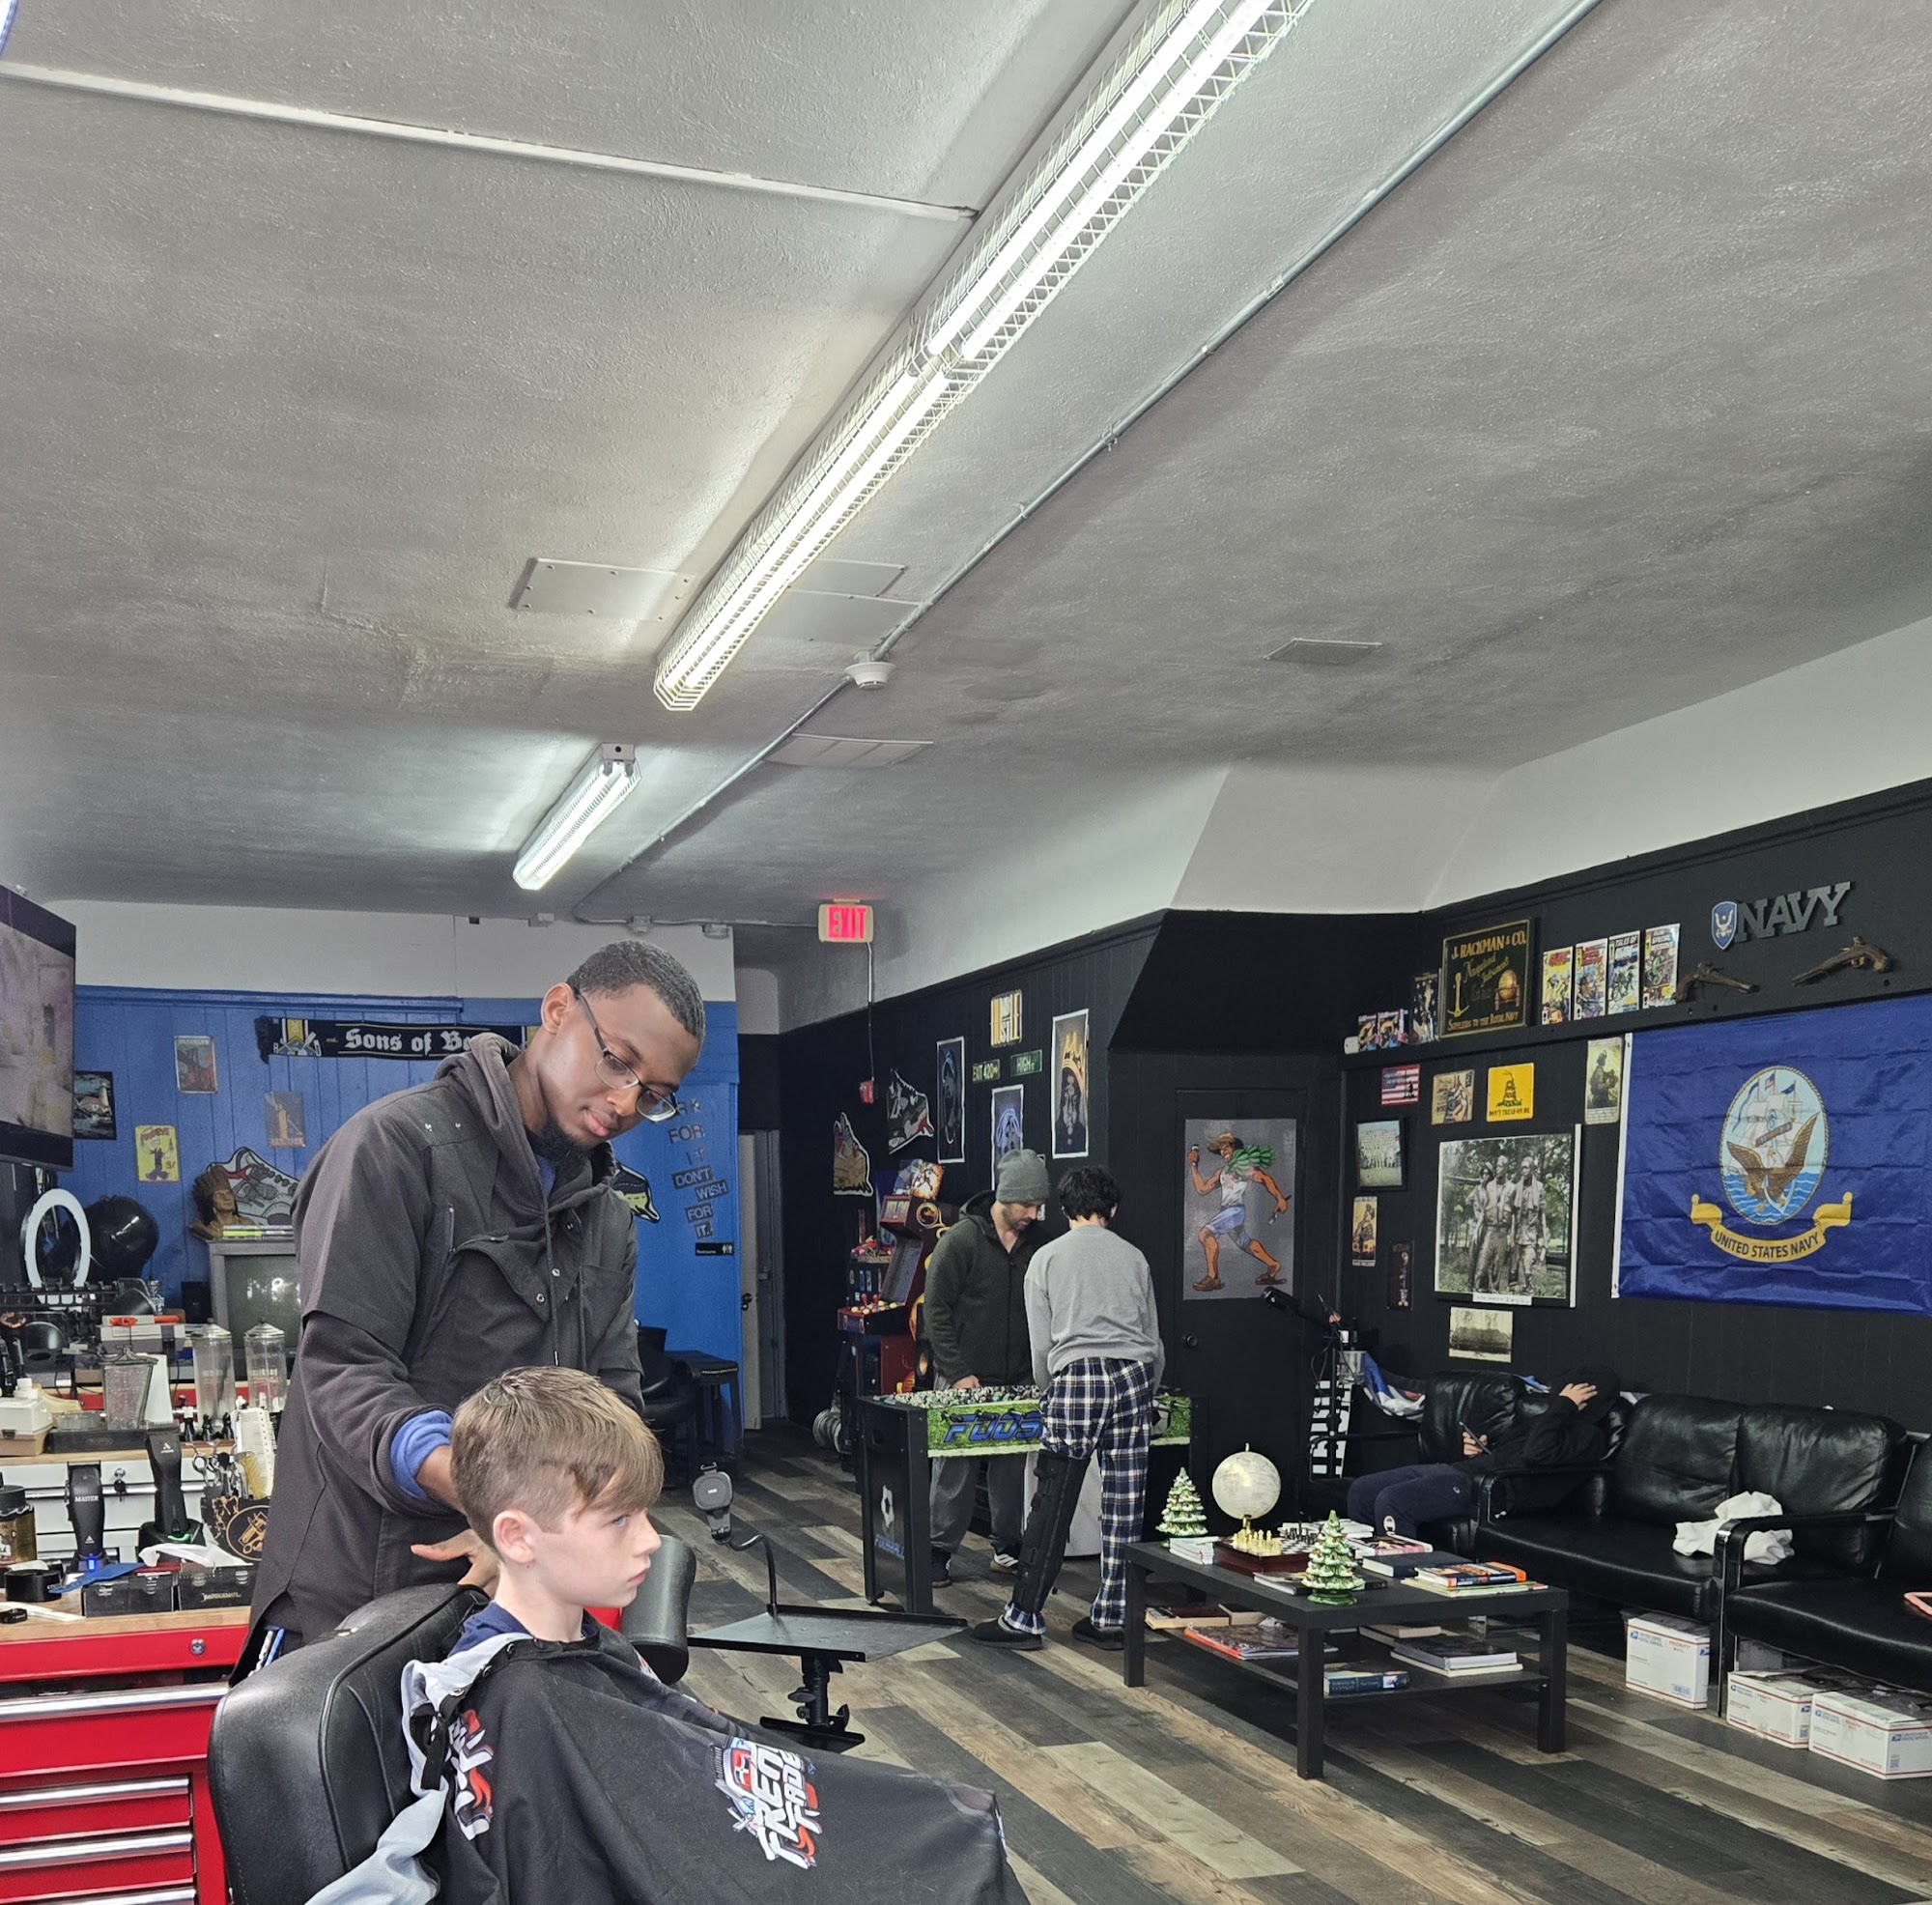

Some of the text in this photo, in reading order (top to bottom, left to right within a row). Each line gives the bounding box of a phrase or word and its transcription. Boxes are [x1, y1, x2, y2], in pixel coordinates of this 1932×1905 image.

[1734, 881, 1851, 943] NAVY
[828, 905, 867, 940] EXIT
[1615, 935, 1638, 948] TALES OF
[344, 1028, 403, 1052] Sons
[411, 1032, 432, 1057] of
[983, 1062, 994, 1080] 420
[668, 1123, 705, 1145] FOR
[686, 1147, 704, 1166] IT
[675, 1167, 711, 1187] DON'T
[696, 1181, 727, 1200] WISH
[687, 1205, 713, 1221] FOR
[1715, 1231, 1819, 1259] UNITED STATES NAVY
[74, 1494, 99, 1503] MASTER
